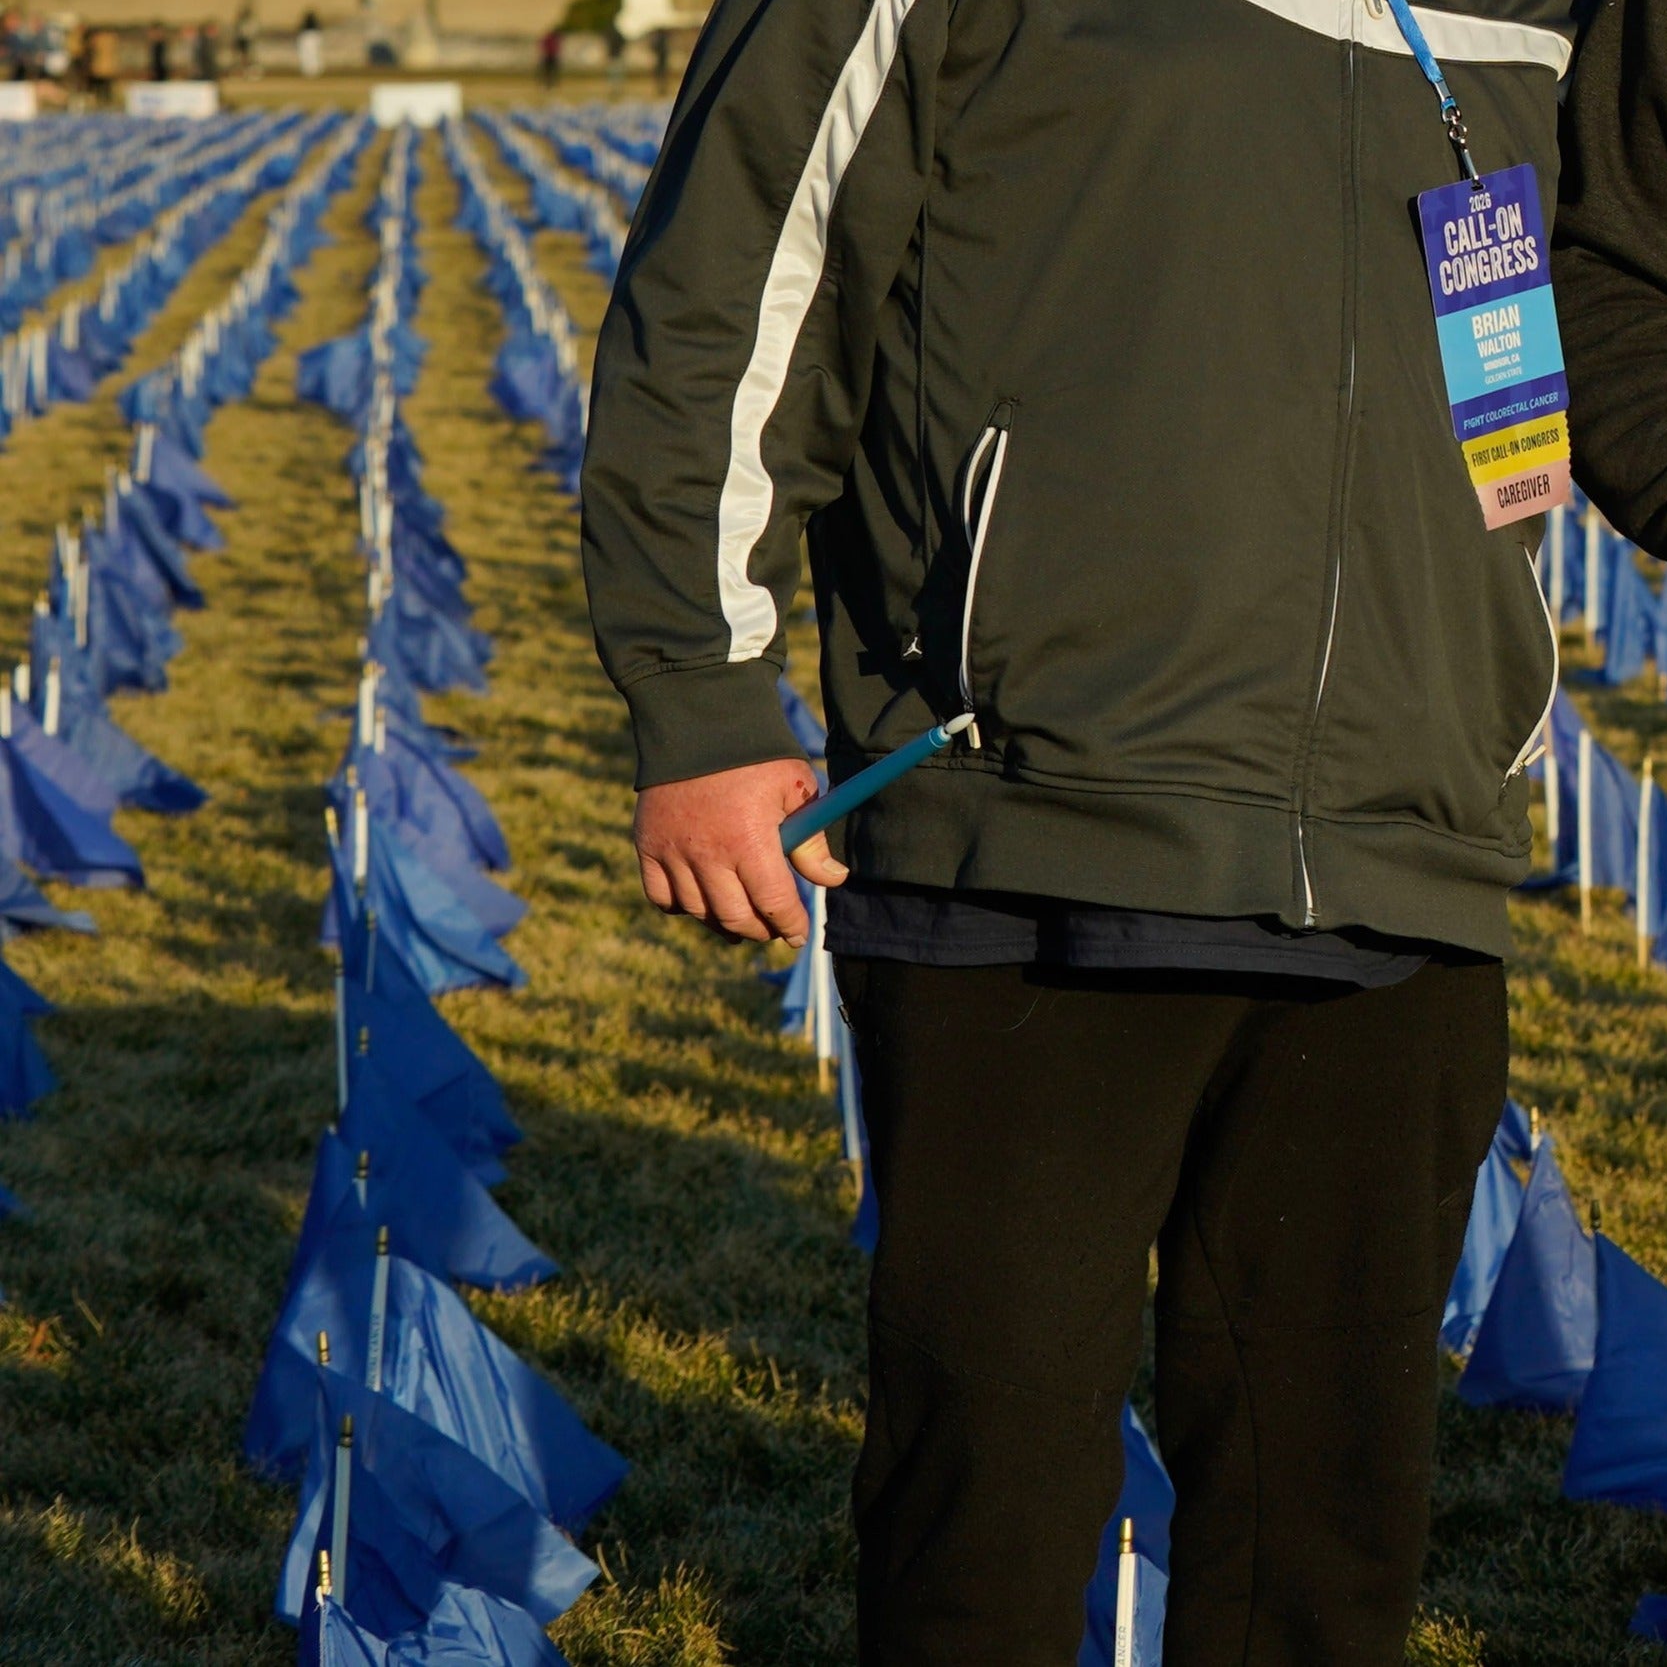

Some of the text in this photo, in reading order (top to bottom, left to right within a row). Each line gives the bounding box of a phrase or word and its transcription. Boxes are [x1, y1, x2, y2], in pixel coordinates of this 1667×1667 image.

[1469, 192, 1491, 213] 2026
[1444, 203, 1524, 256] CALL-ON
[1439, 236, 1539, 295] CONGRESS
[1471, 304, 1521, 340] BRIAN
[1477, 331, 1521, 358] WALTON
[1463, 392, 1559, 430] FIGHT COLORECTAL CANCER
[1471, 428, 1560, 467] FIRST CALL-ON CONGRESS
[1497, 473, 1551, 509] CAREGIVER
[1117, 1626, 1127, 1666] ANCER
